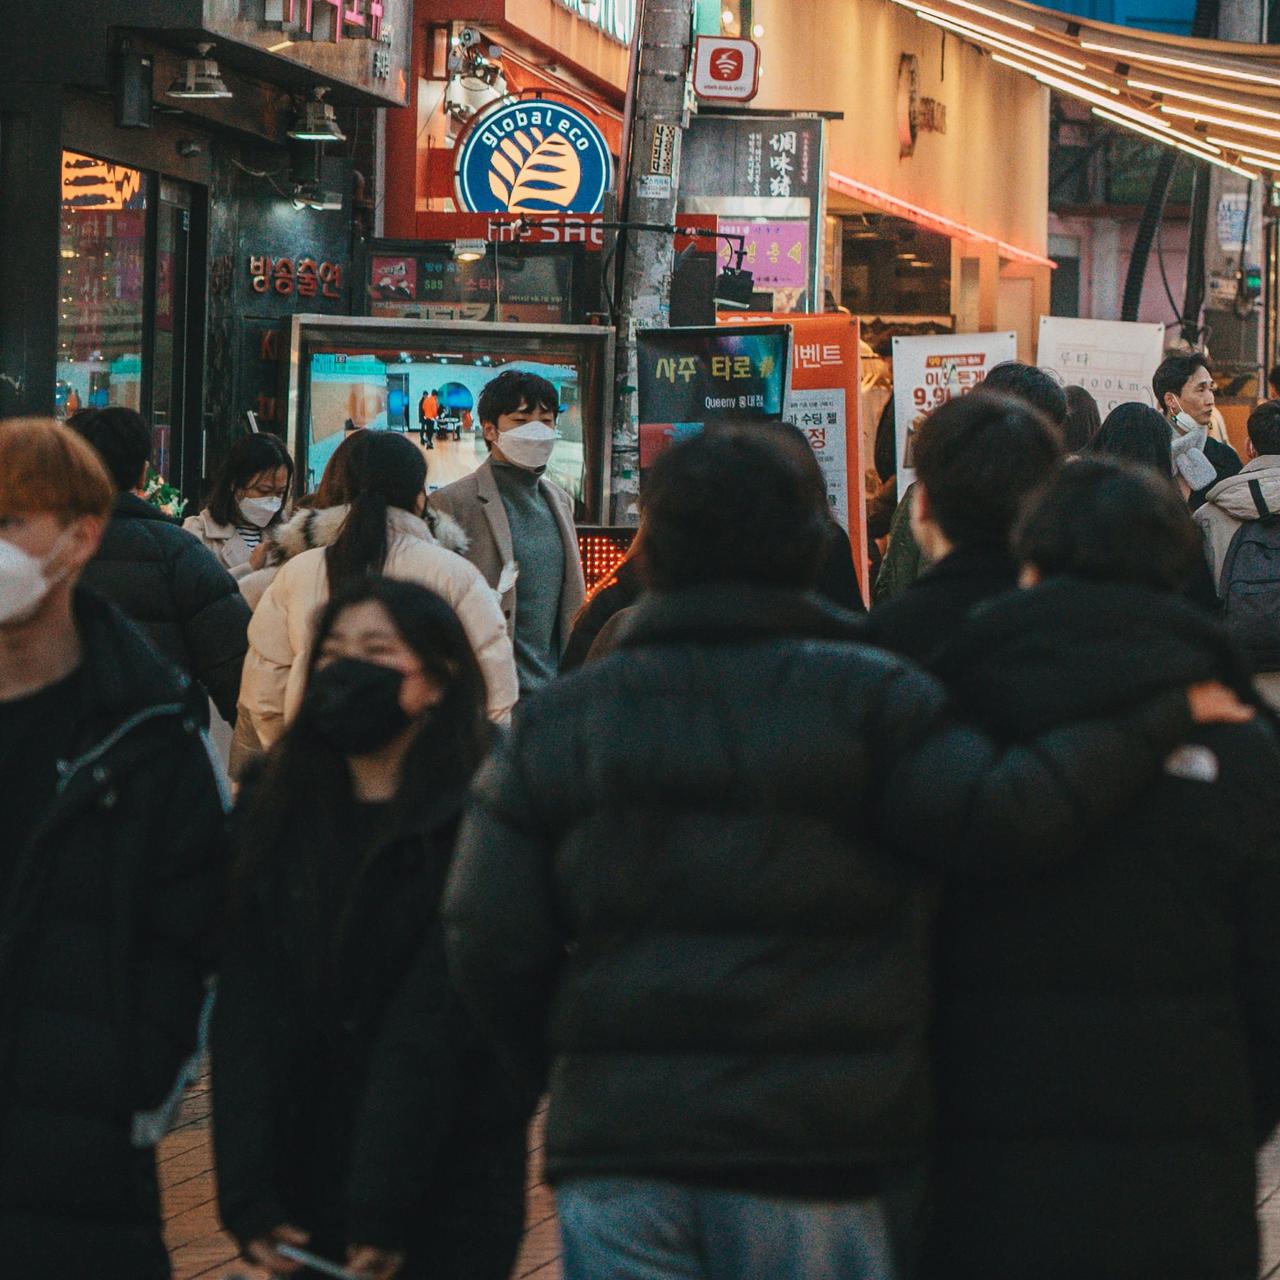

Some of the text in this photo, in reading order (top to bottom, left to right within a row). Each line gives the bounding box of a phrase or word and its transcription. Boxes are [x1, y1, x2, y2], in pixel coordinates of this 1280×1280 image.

[482, 108, 590, 150] global eco
[249, 254, 341, 299] 방송출연
[655, 356, 698, 382] 사주
[711, 355, 751, 381] 타로
[705, 395, 764, 409] Queeny 홍대점
[801, 412, 823, 426] 수딩
